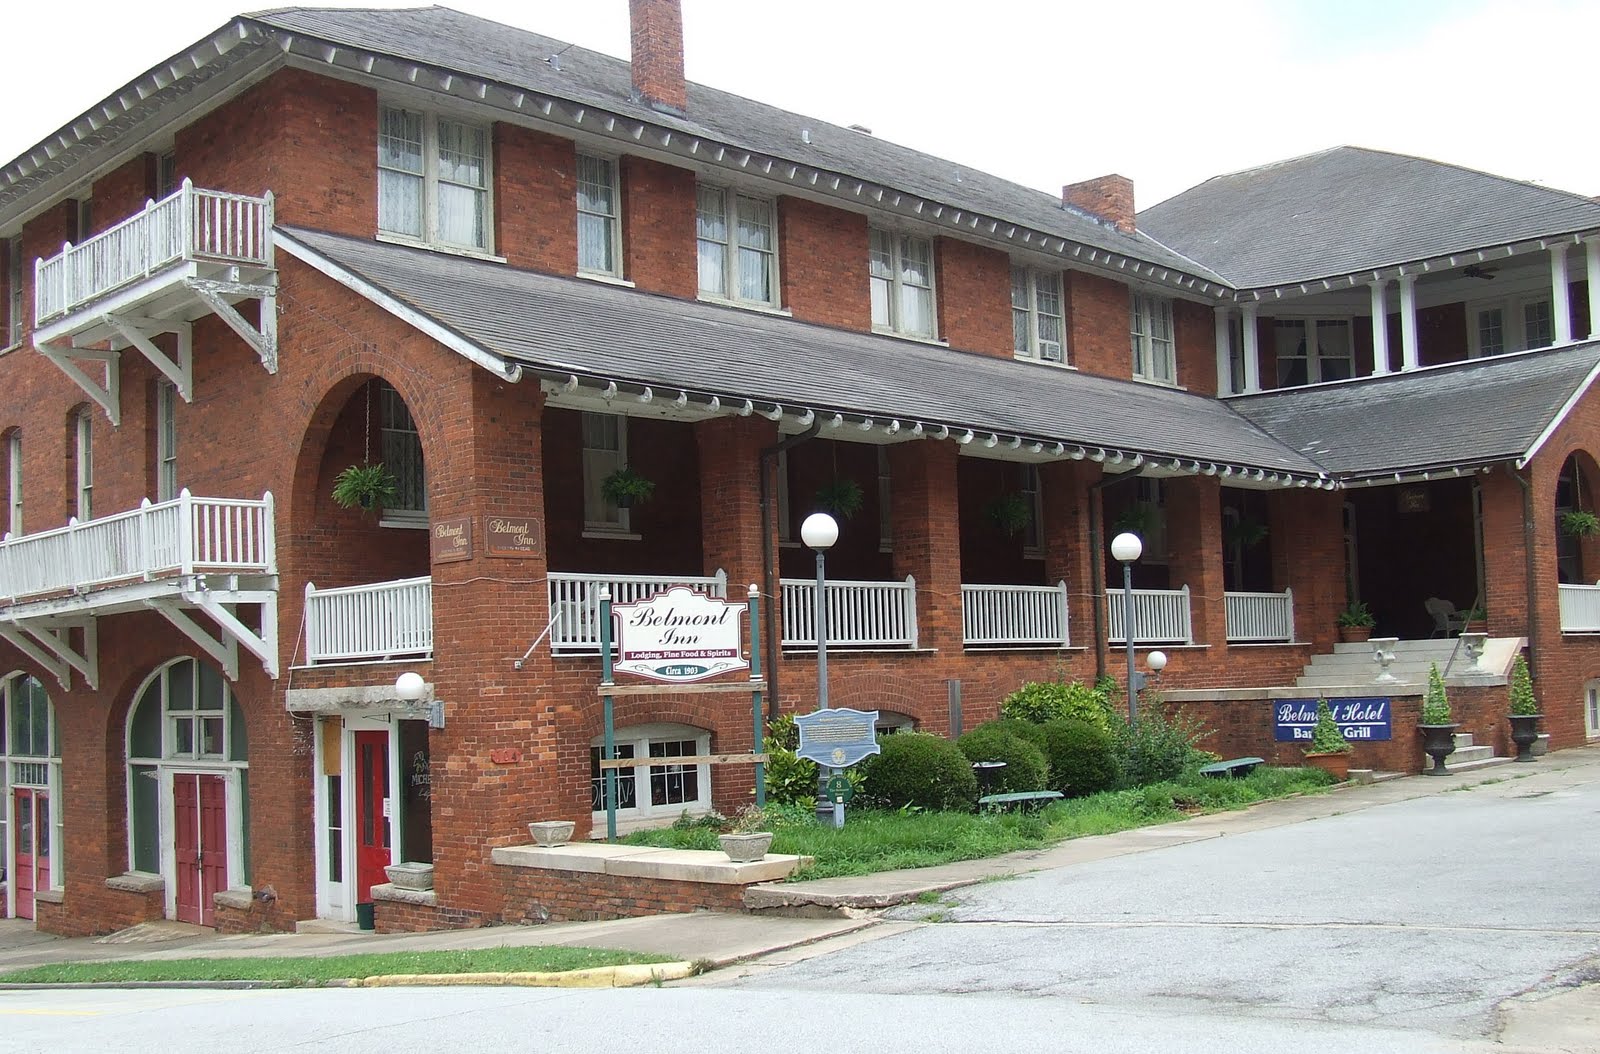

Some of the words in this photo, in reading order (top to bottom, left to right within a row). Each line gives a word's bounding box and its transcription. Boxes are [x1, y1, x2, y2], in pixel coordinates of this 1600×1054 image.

[435, 523, 463, 538] Belmont
[489, 519, 529, 534] Belmont
[453, 535, 468, 548] Inn
[513, 534, 537, 546] Inn
[629, 606, 731, 627] Belmont
[658, 628, 701, 645] Inn
[631, 651, 662, 660] Lodging,
[664, 651, 680, 659] Fine
[680, 650, 699, 658] Food
[707, 650, 731, 659] Spirits
[665, 667, 682, 675] Circa
[684, 666, 698, 675] 1903
[1278, 704, 1339, 721] Belmt
[1342, 703, 1385, 720] Hotel
[1344, 727, 1371, 738] Grill
